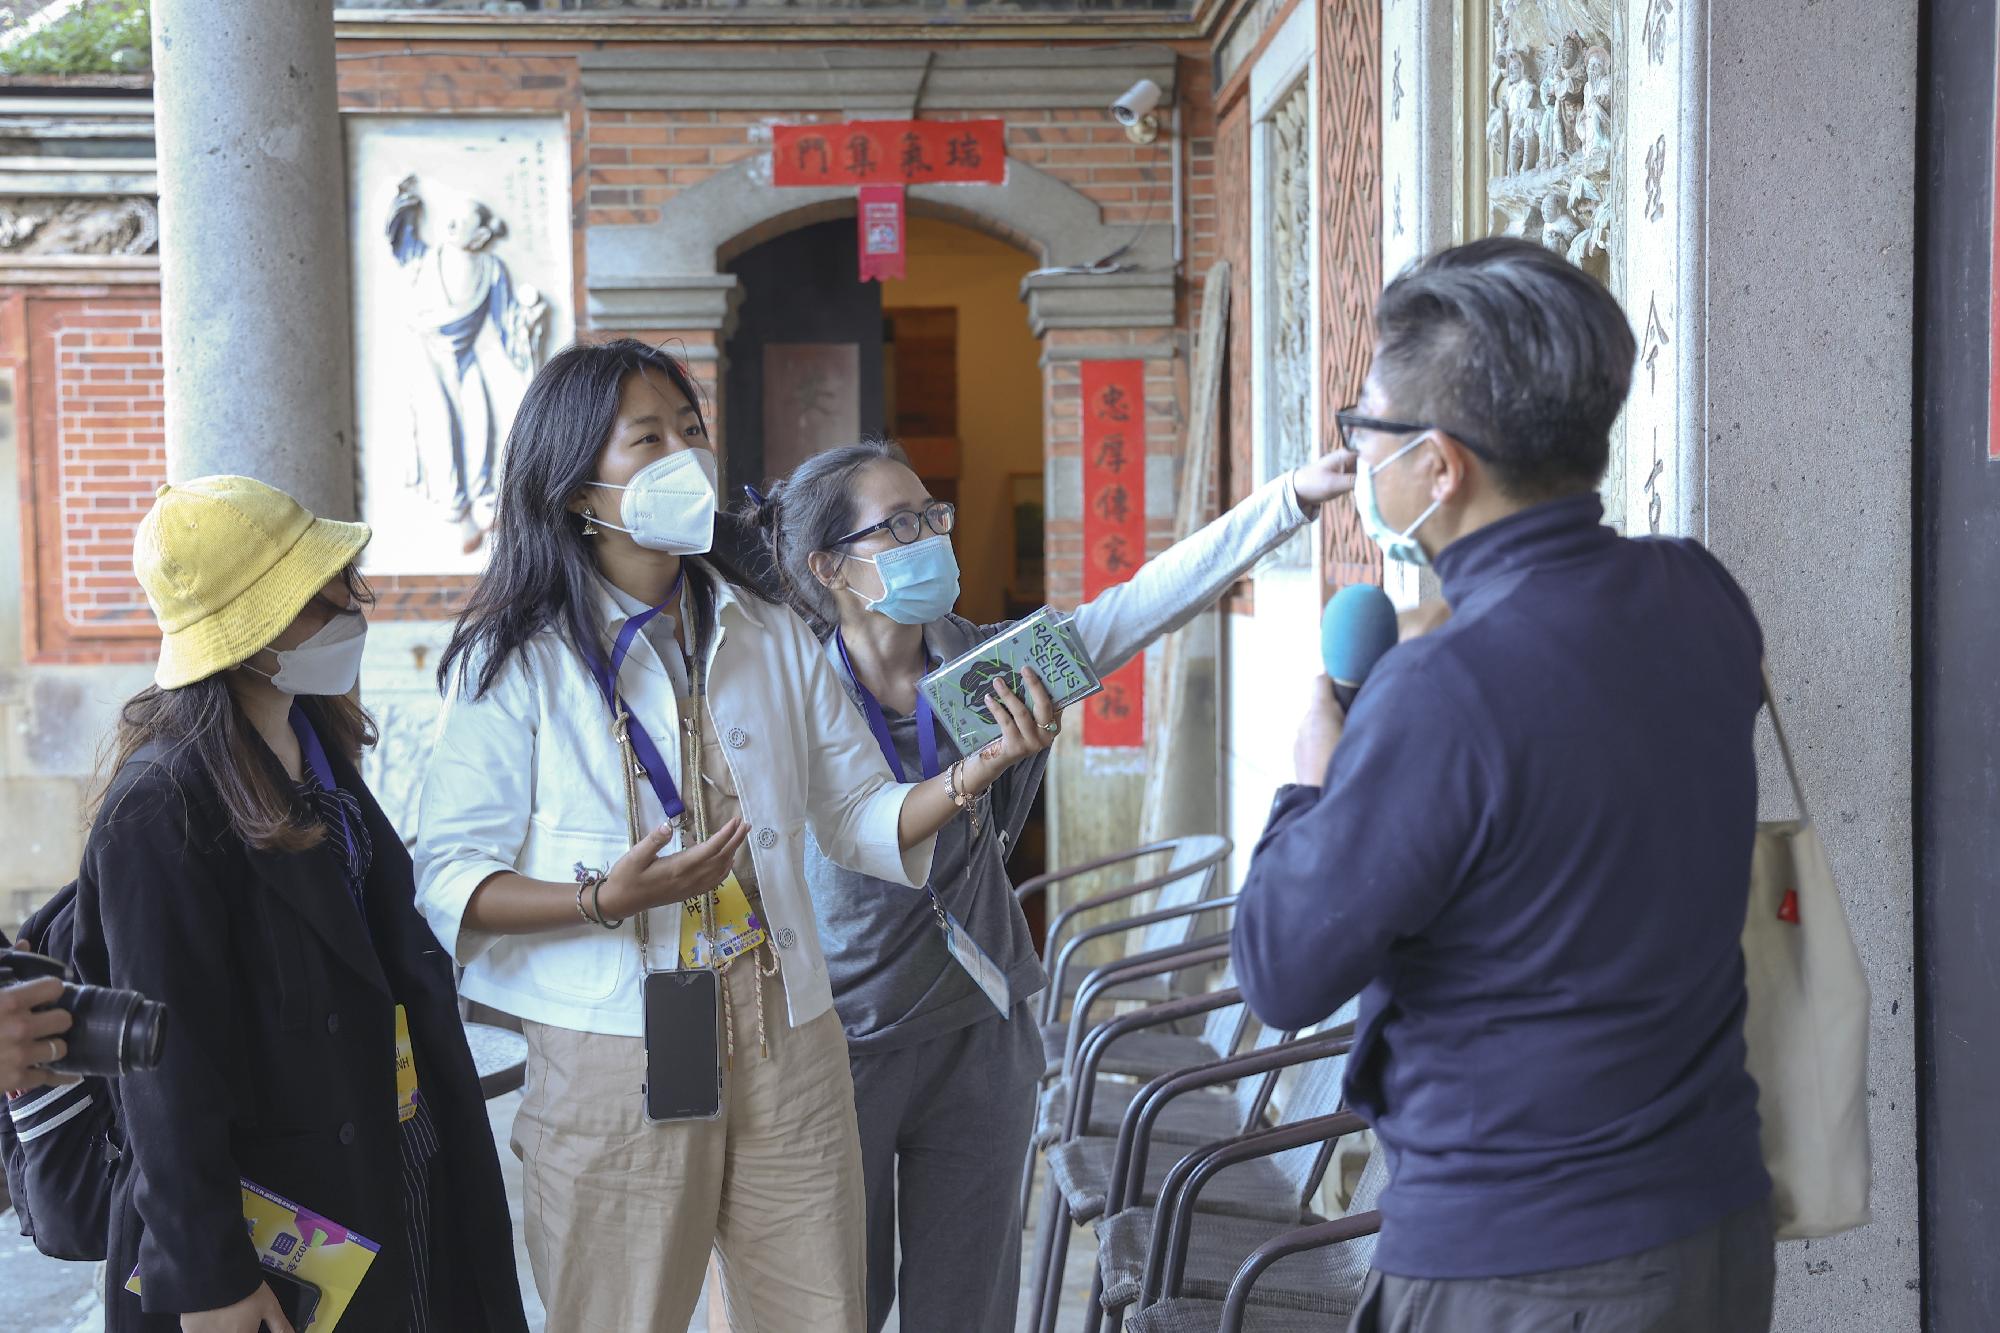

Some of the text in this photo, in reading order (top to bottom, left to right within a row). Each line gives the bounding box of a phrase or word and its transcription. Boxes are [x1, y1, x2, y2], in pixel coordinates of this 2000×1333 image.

[795, 131, 982, 177] 瑞氣集門
[1029, 644, 1062, 685] SELU
[1032, 622, 1081, 689] RAKNUS
